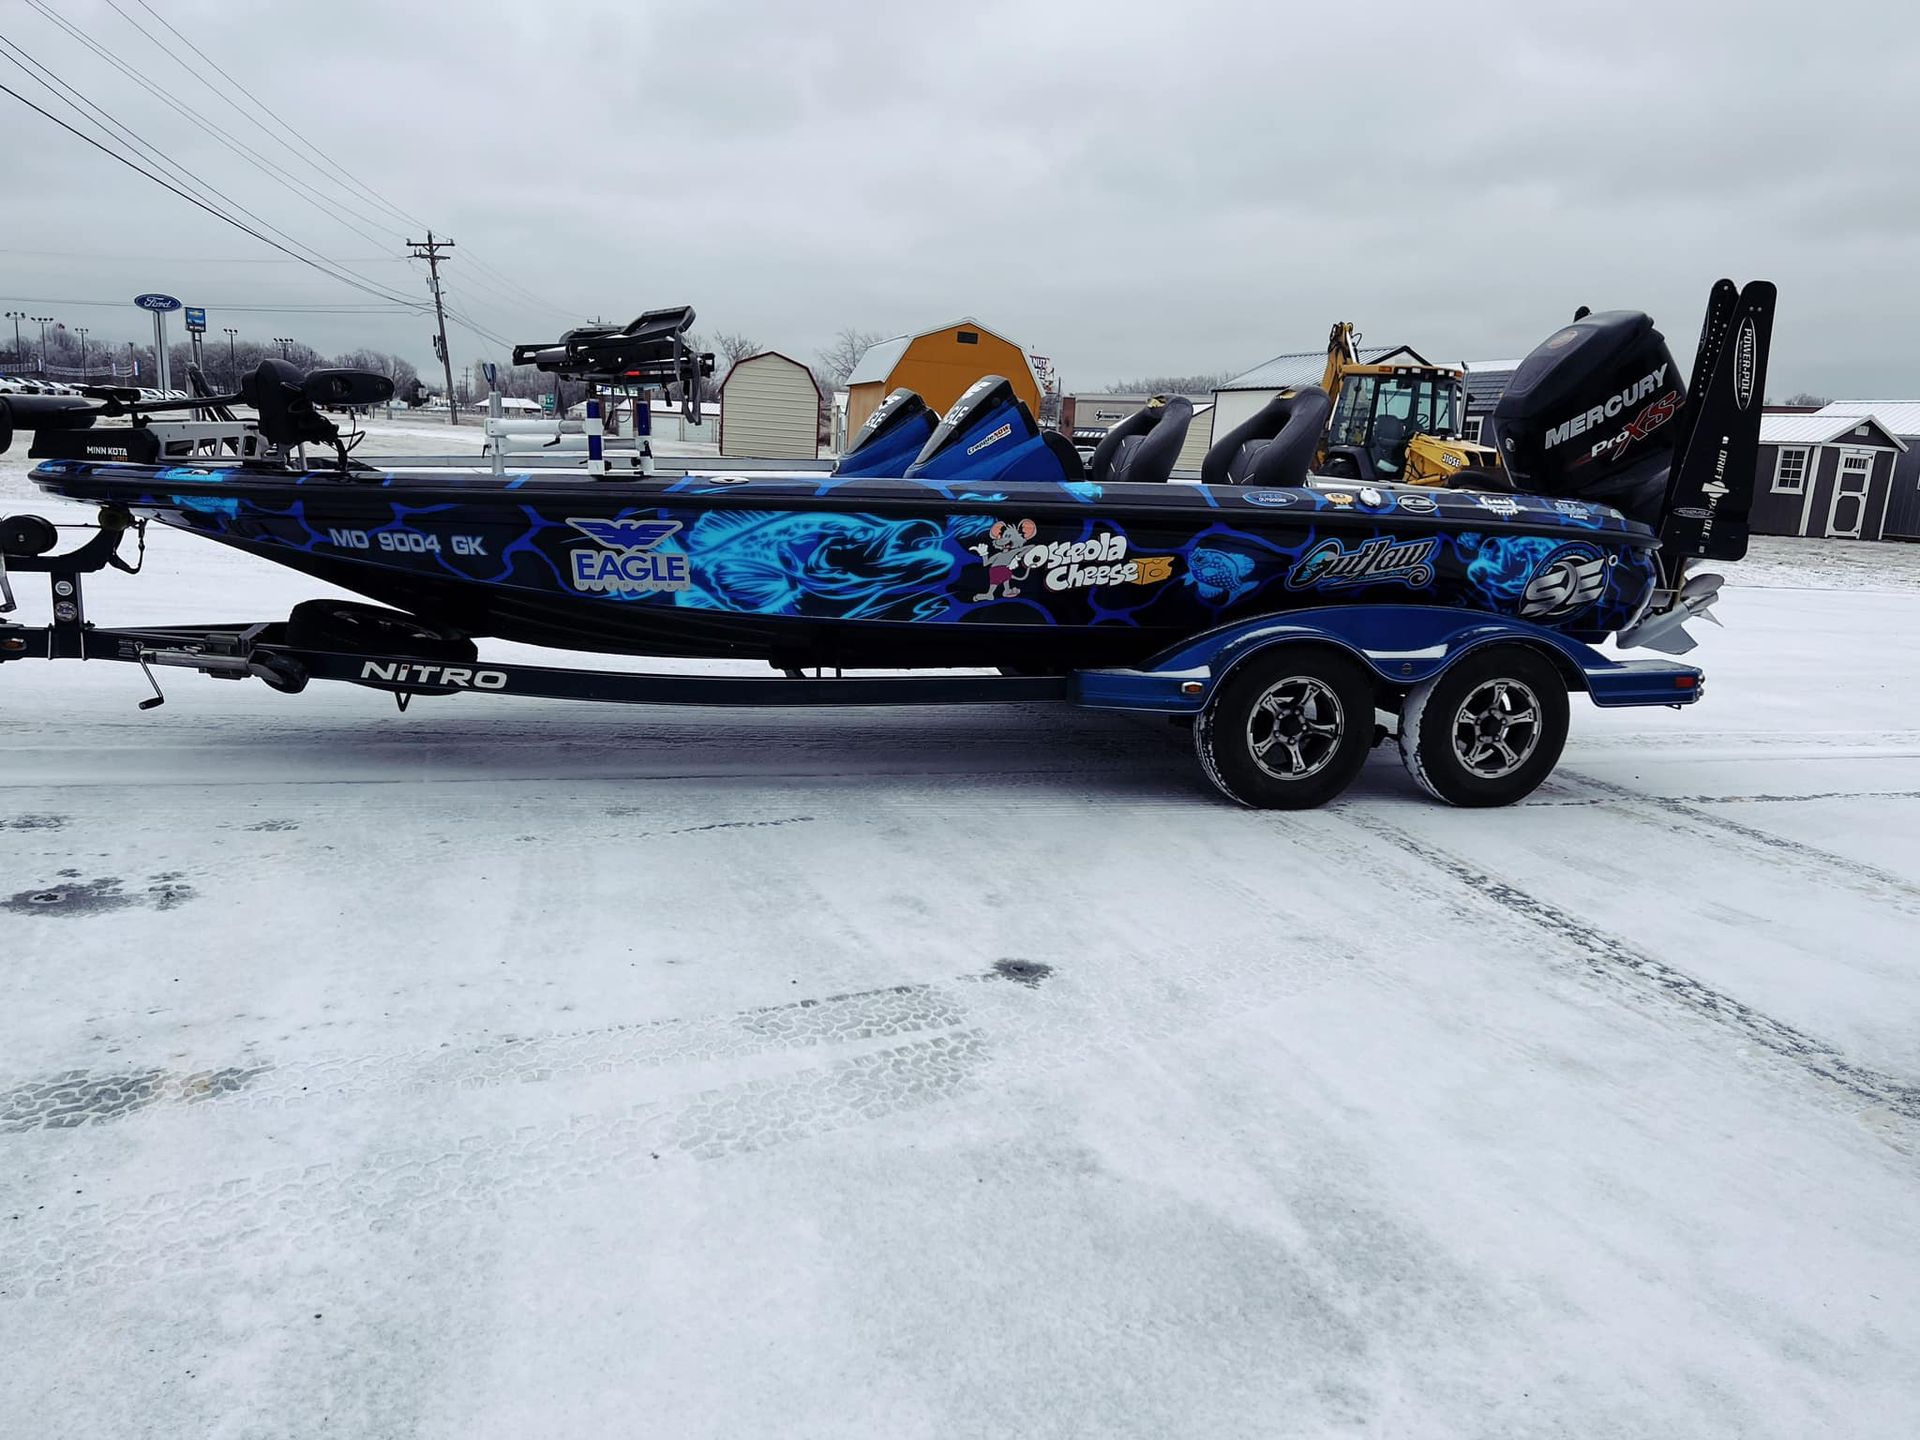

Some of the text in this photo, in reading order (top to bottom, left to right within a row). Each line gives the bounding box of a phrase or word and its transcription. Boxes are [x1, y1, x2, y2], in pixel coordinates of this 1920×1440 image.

[144, 297, 172, 308] Ford
[1740, 327, 1753, 399] POWER-POLE
[1544, 363, 1668, 450] MERCURY
[86, 446, 128, 456] MINN KOTA
[1701, 449, 1728, 540] DRIFT PDLE
[328, 528, 489, 556] MO 9004 GK
[1023, 532, 1127, 569] Osceola
[575, 553, 686, 582] EAGLE
[1045, 562, 1139, 591] Cheese
[1288, 541, 1434, 588] Outlaw
